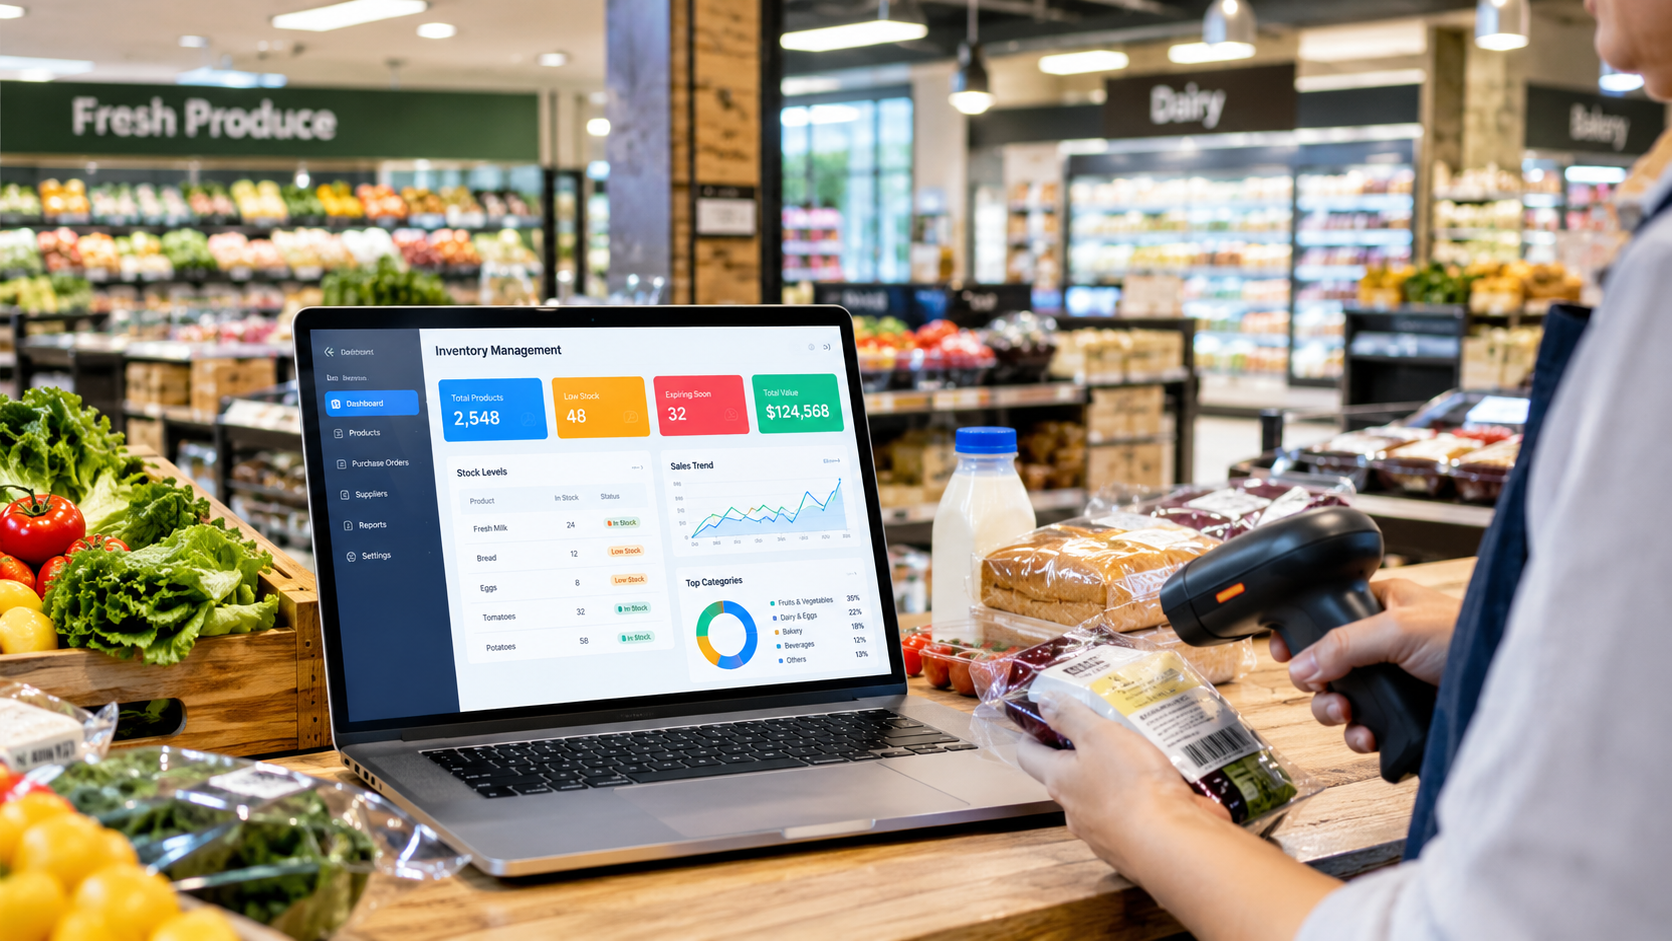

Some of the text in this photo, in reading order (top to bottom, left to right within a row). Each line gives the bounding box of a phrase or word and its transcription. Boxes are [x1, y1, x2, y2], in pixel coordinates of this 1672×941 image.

[1150, 82, 1226, 129] Dairy
[72, 96, 338, 141] Fresh Produce
[435, 345, 562, 358] Inventory Management
[451, 394, 504, 402] Total Products
[564, 392, 600, 400] Low Stock
[665, 390, 711, 399] Expiring Soon
[566, 408, 586, 423] 48
[668, 407, 687, 421] 32
[766, 404, 830, 420] $124,568
[454, 410, 500, 428] 2,548
[352, 460, 384, 468] Purchase
[670, 461, 714, 470] Sales Trend
[456, 467, 507, 477] Stock Levels
[355, 490, 388, 499] Suppliers
[359, 521, 387, 530] Reports
[473, 524, 508, 533] Fresh Milk
[362, 552, 392, 561] Settings
[571, 550, 579, 558] 12
[686, 576, 743, 588] Top Categories
[480, 584, 497, 593] Eggs
[801, 597, 833, 606] Vegetables
[483, 613, 516, 621] Tomatoes
[802, 612, 817, 620] Eggs
[782, 627, 802, 636] Bakery
[579, 637, 589, 645] 58
[784, 641, 815, 650] Beverages
[486, 643, 516, 651] Potatoes
[855, 650, 868, 658] 13%
[786, 656, 806, 664] Others
